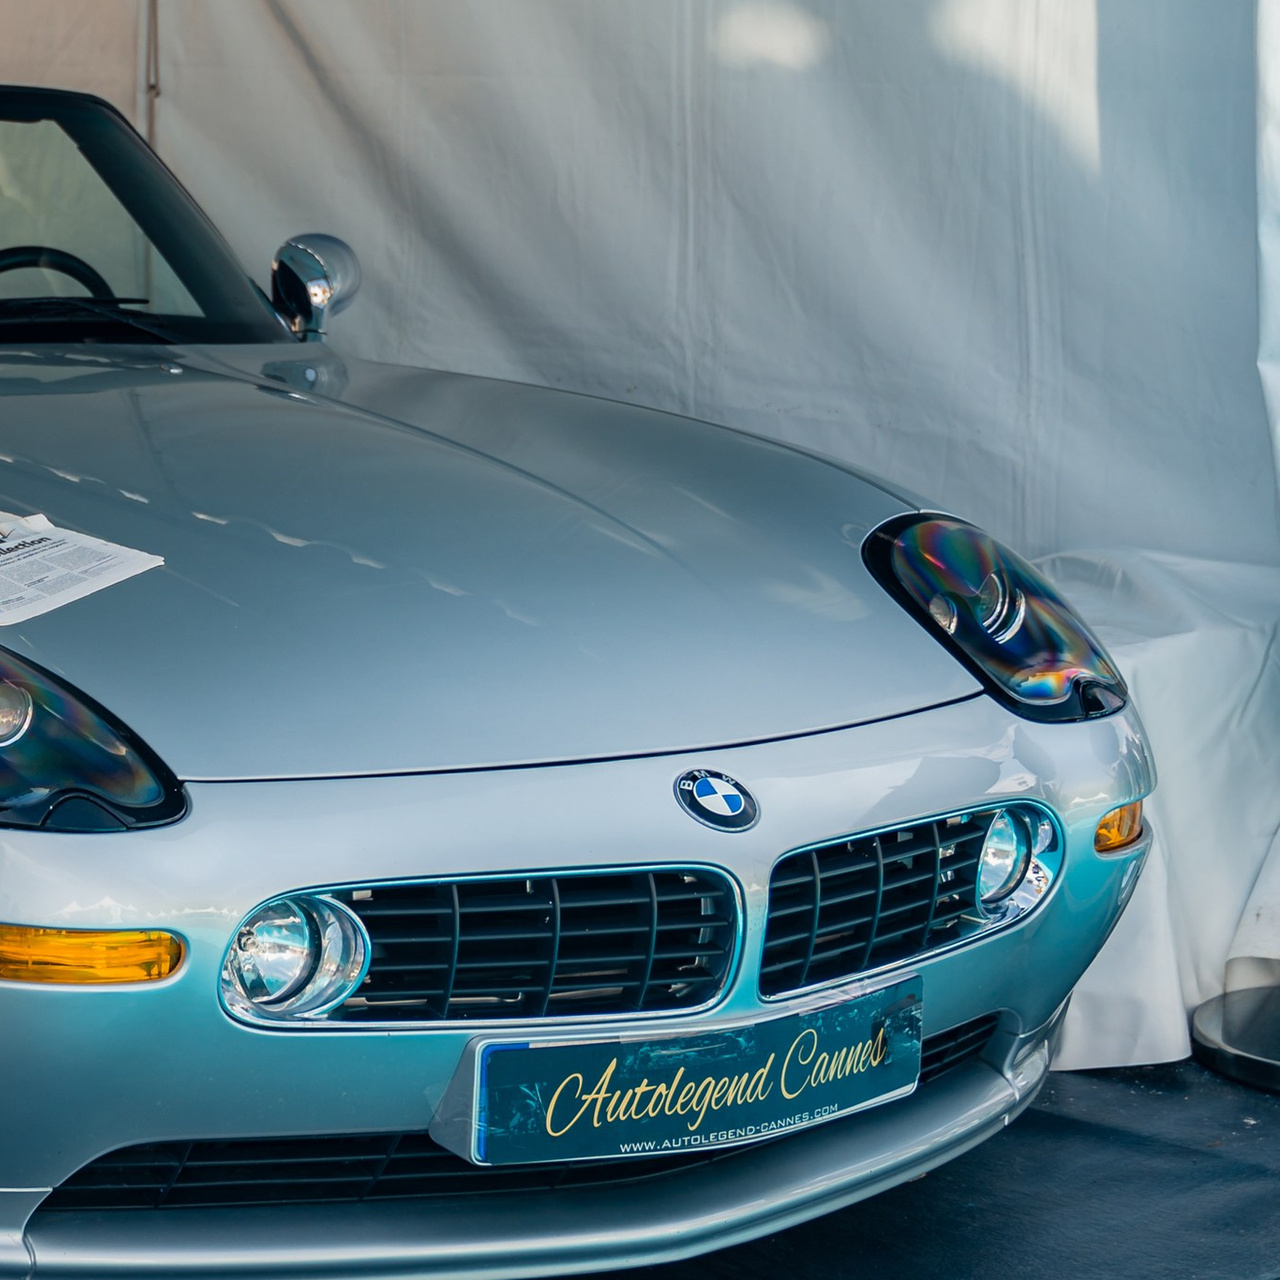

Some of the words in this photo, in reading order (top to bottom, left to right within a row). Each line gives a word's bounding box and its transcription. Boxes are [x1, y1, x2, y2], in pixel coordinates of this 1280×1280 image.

[680, 770, 736, 791] BMW
[545, 1053, 776, 1137] Autolegend
[780, 1027, 887, 1100] Cannes
[620, 1103, 838, 1153] WWW.AUTOLEGEND-CANNES.COM
